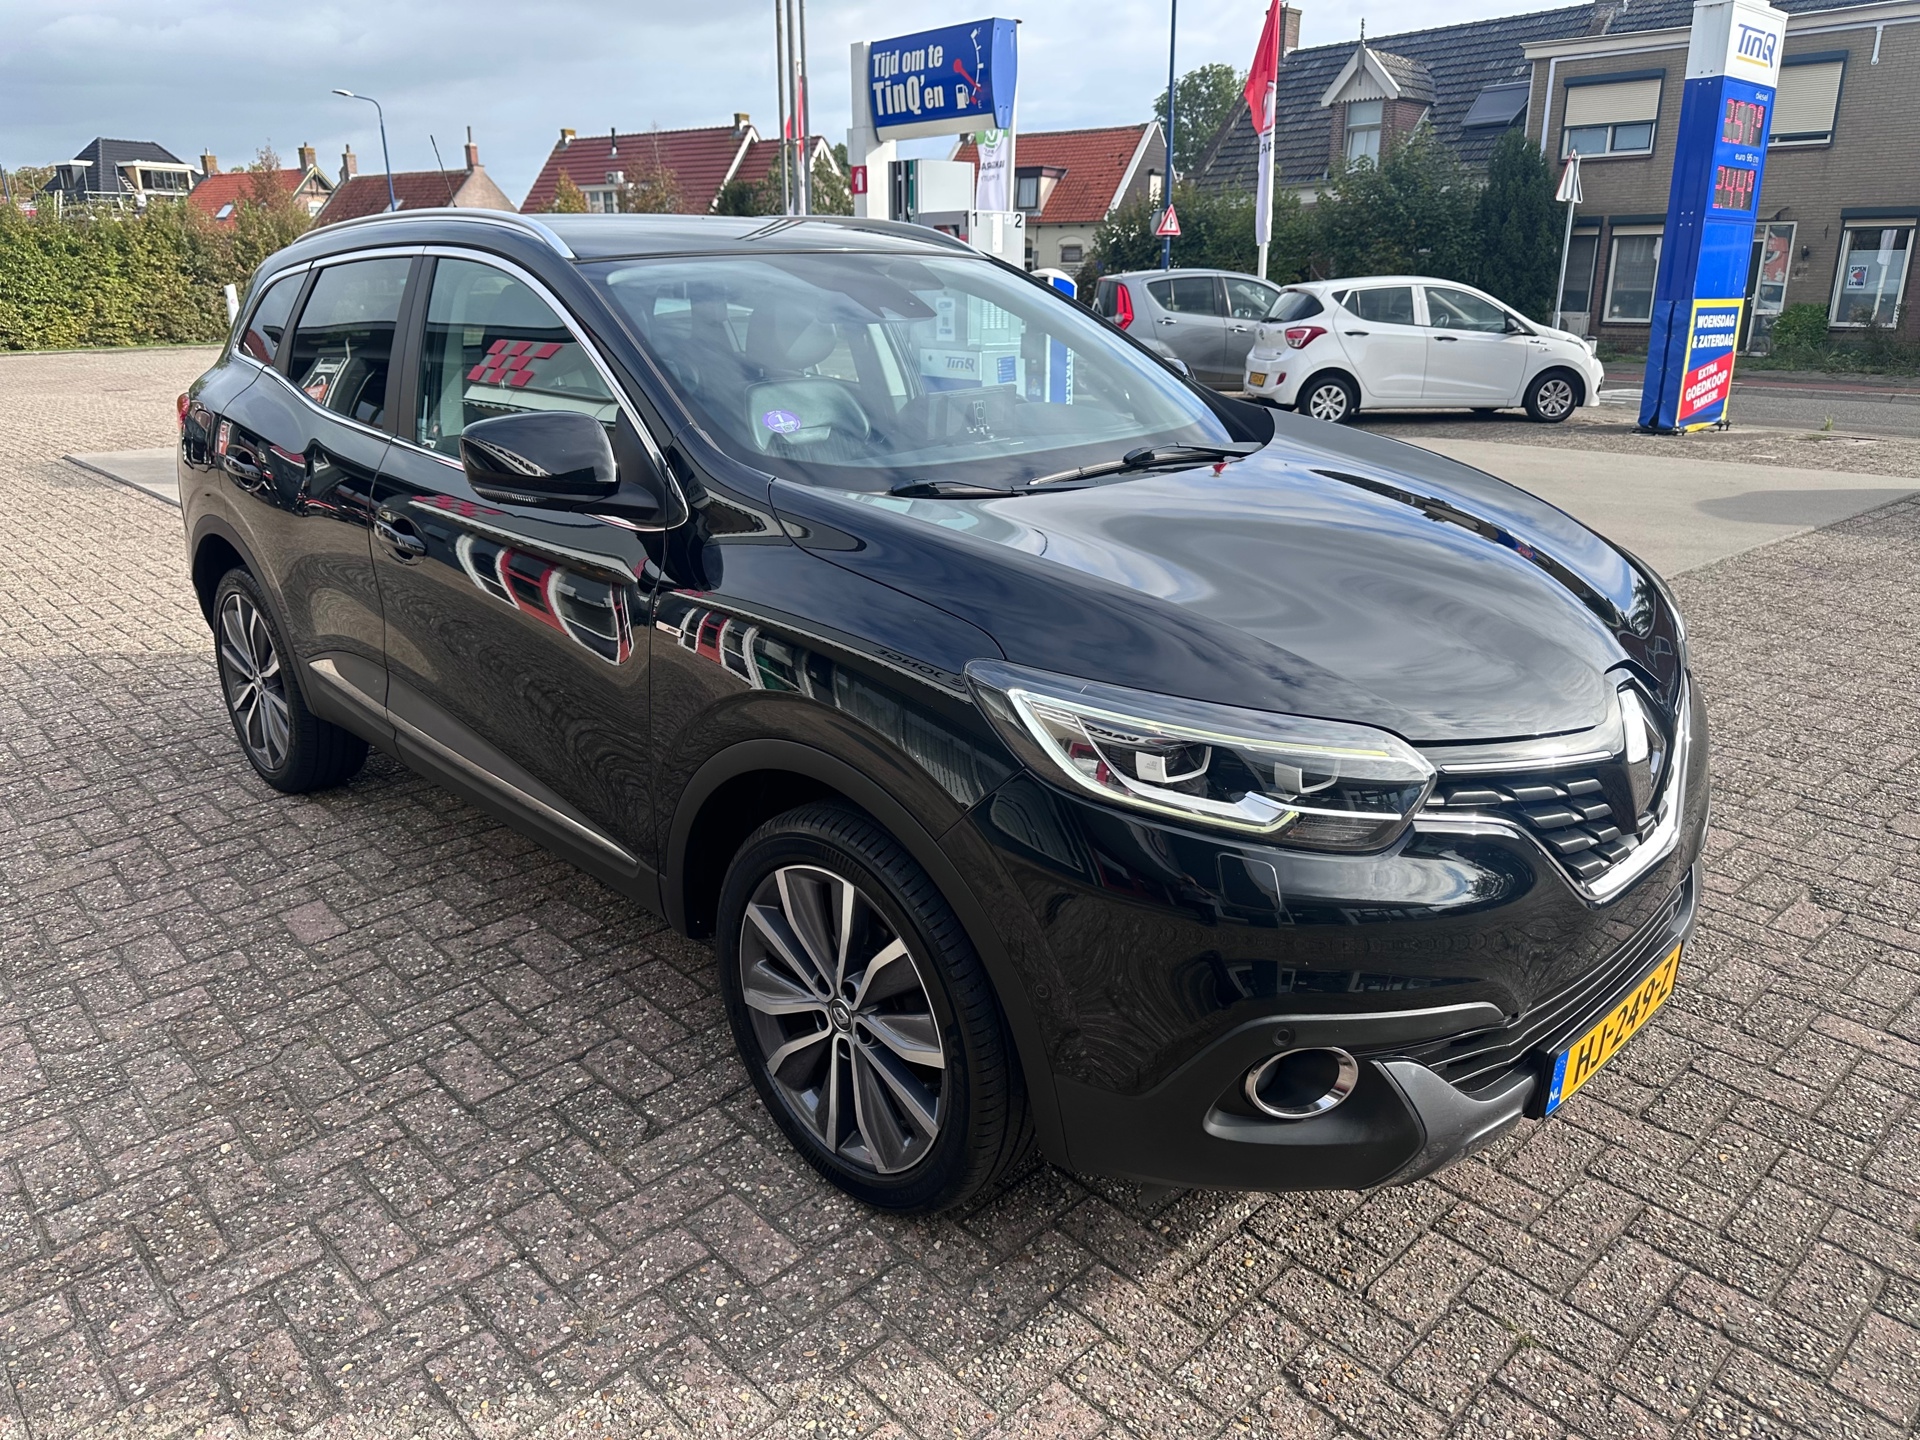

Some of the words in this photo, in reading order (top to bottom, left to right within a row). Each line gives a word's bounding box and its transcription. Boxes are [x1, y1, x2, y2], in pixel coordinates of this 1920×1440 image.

[1738, 23, 1777, 68] TinQ
[873, 49, 900, 79] Tijd
[902, 49, 925, 73] om
[928, 44, 944, 68] te
[1755, 91, 1769, 102] diesel
[972, 211, 978, 227] 1
[1014, 213, 1022, 229] 2
[1697, 314, 1735, 328] WOENSDAG
[1692, 335, 1697, 348] &
[1698, 333, 1734, 348] ZATERDAG
[945, 356, 975, 373] TinQ
[1698, 362, 1718, 380] EXTRA
[1685, 370, 1728, 401] GOEDKOOP
[1573, 957, 1675, 1085] HJ-249-Z
[1548, 1087, 1560, 1104] NL
